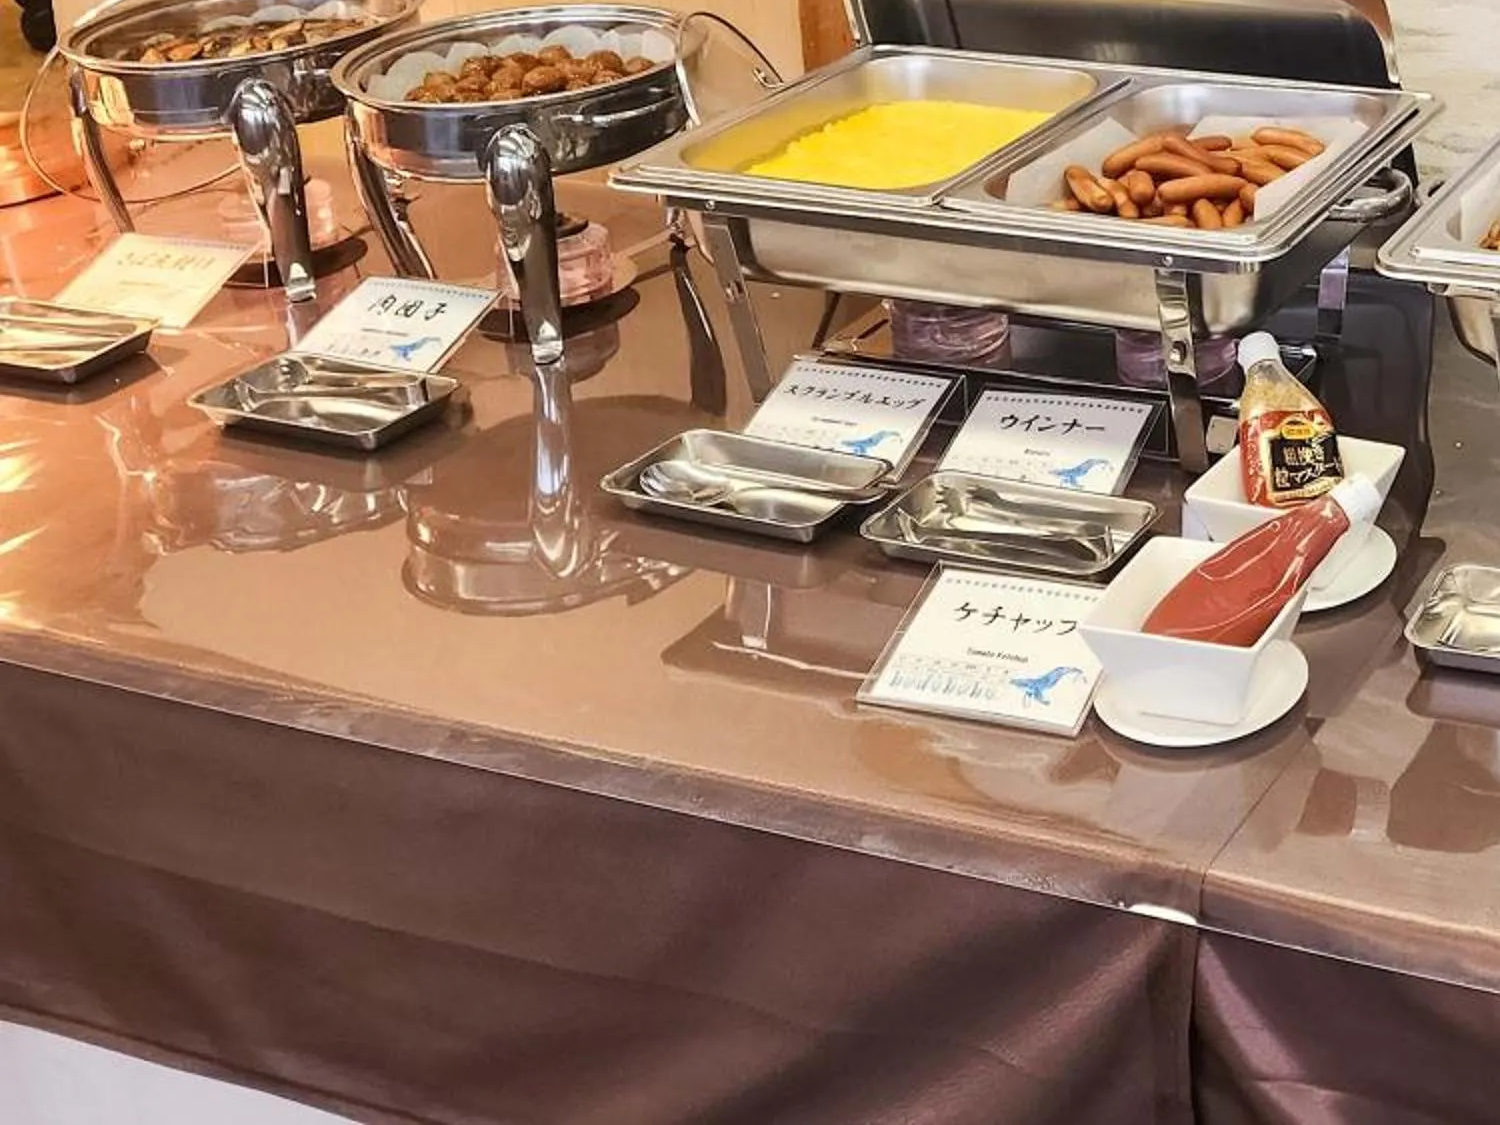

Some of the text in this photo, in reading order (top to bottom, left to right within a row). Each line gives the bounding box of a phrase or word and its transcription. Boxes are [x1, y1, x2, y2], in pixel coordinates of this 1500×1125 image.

[1000, 414, 1105, 435] ウインナー
